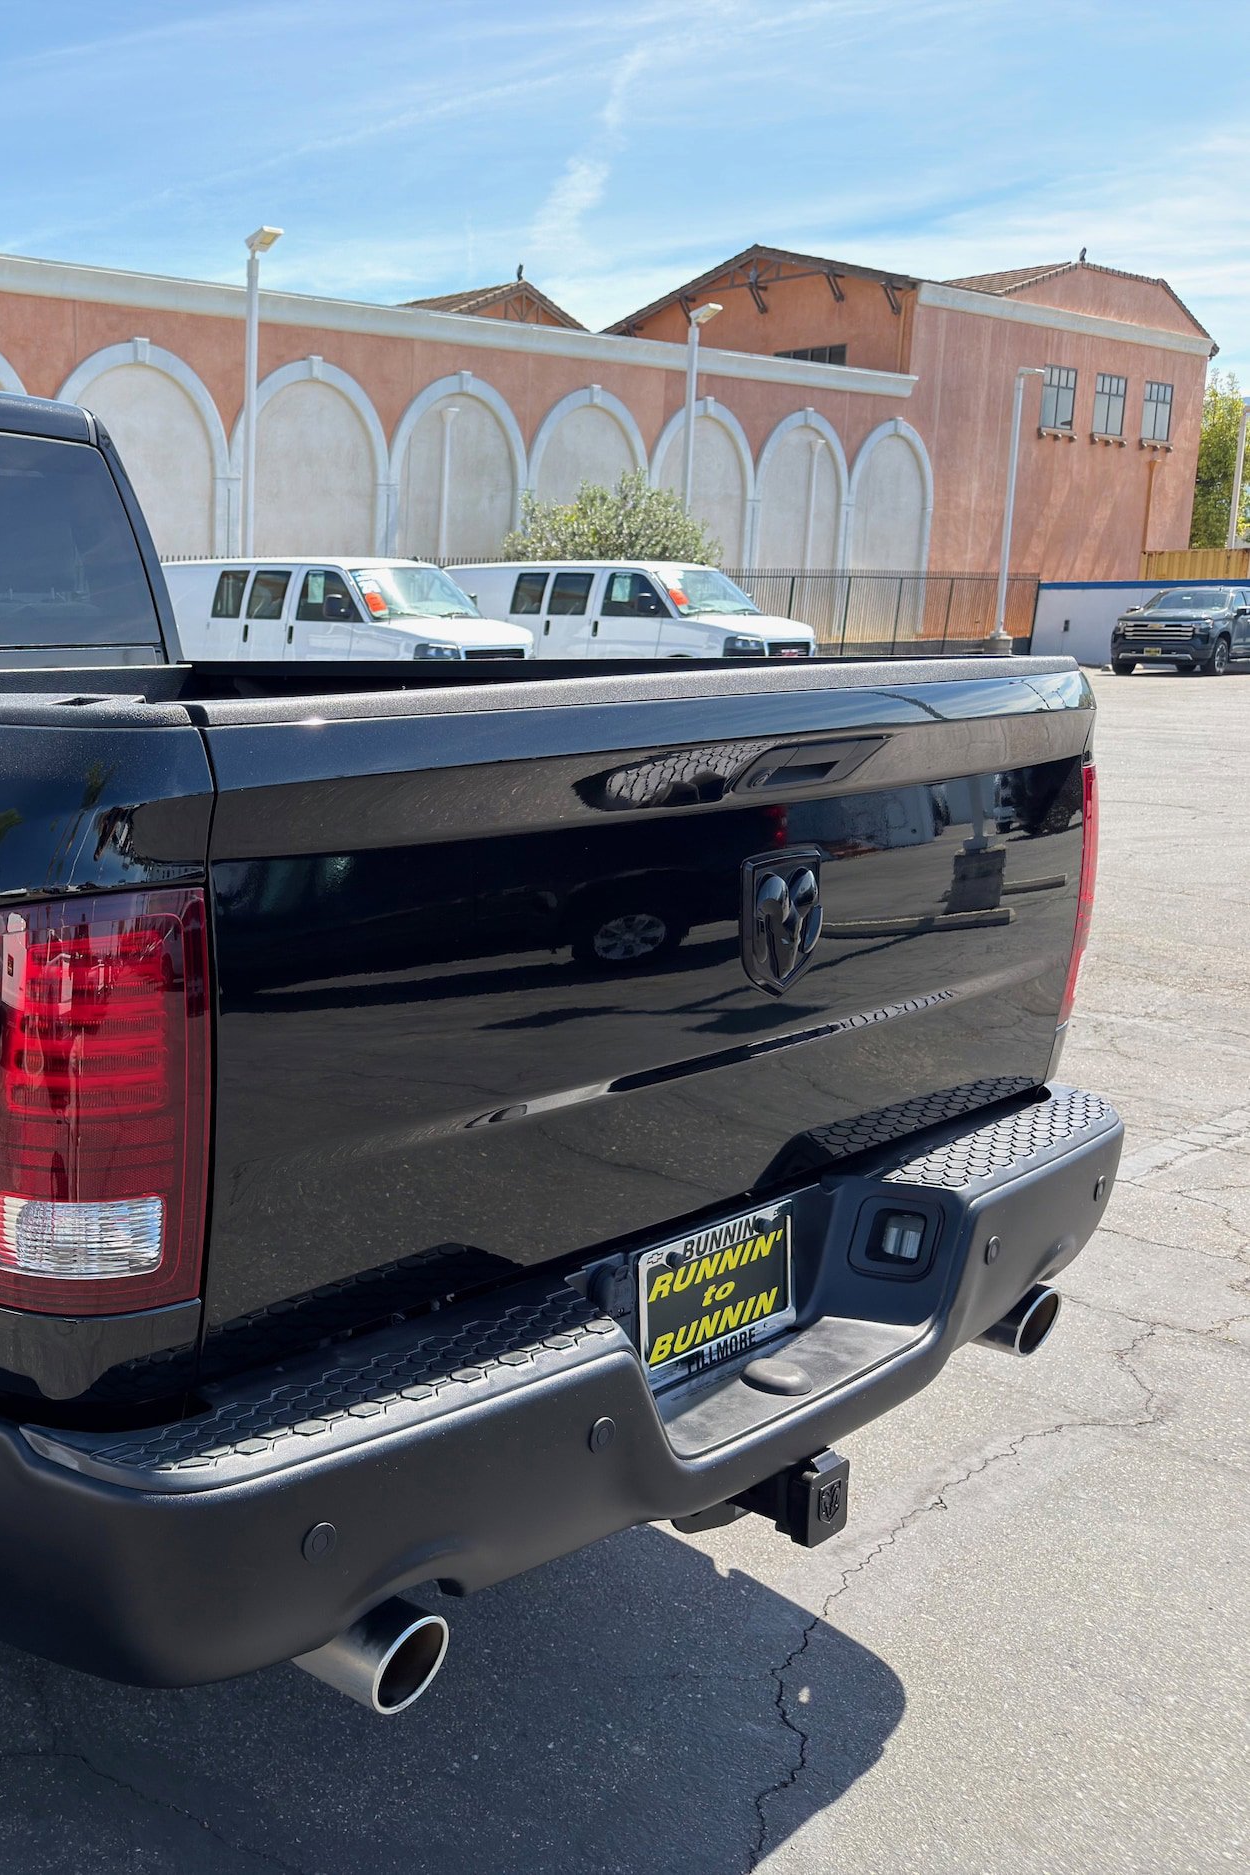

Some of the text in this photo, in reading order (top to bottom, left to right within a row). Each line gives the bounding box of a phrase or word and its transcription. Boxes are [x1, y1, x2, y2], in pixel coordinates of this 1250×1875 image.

[683, 1216, 757, 1260] BUNNIN
[702, 1281, 735, 1307] to
[648, 1287, 778, 1365] BUNNIN
